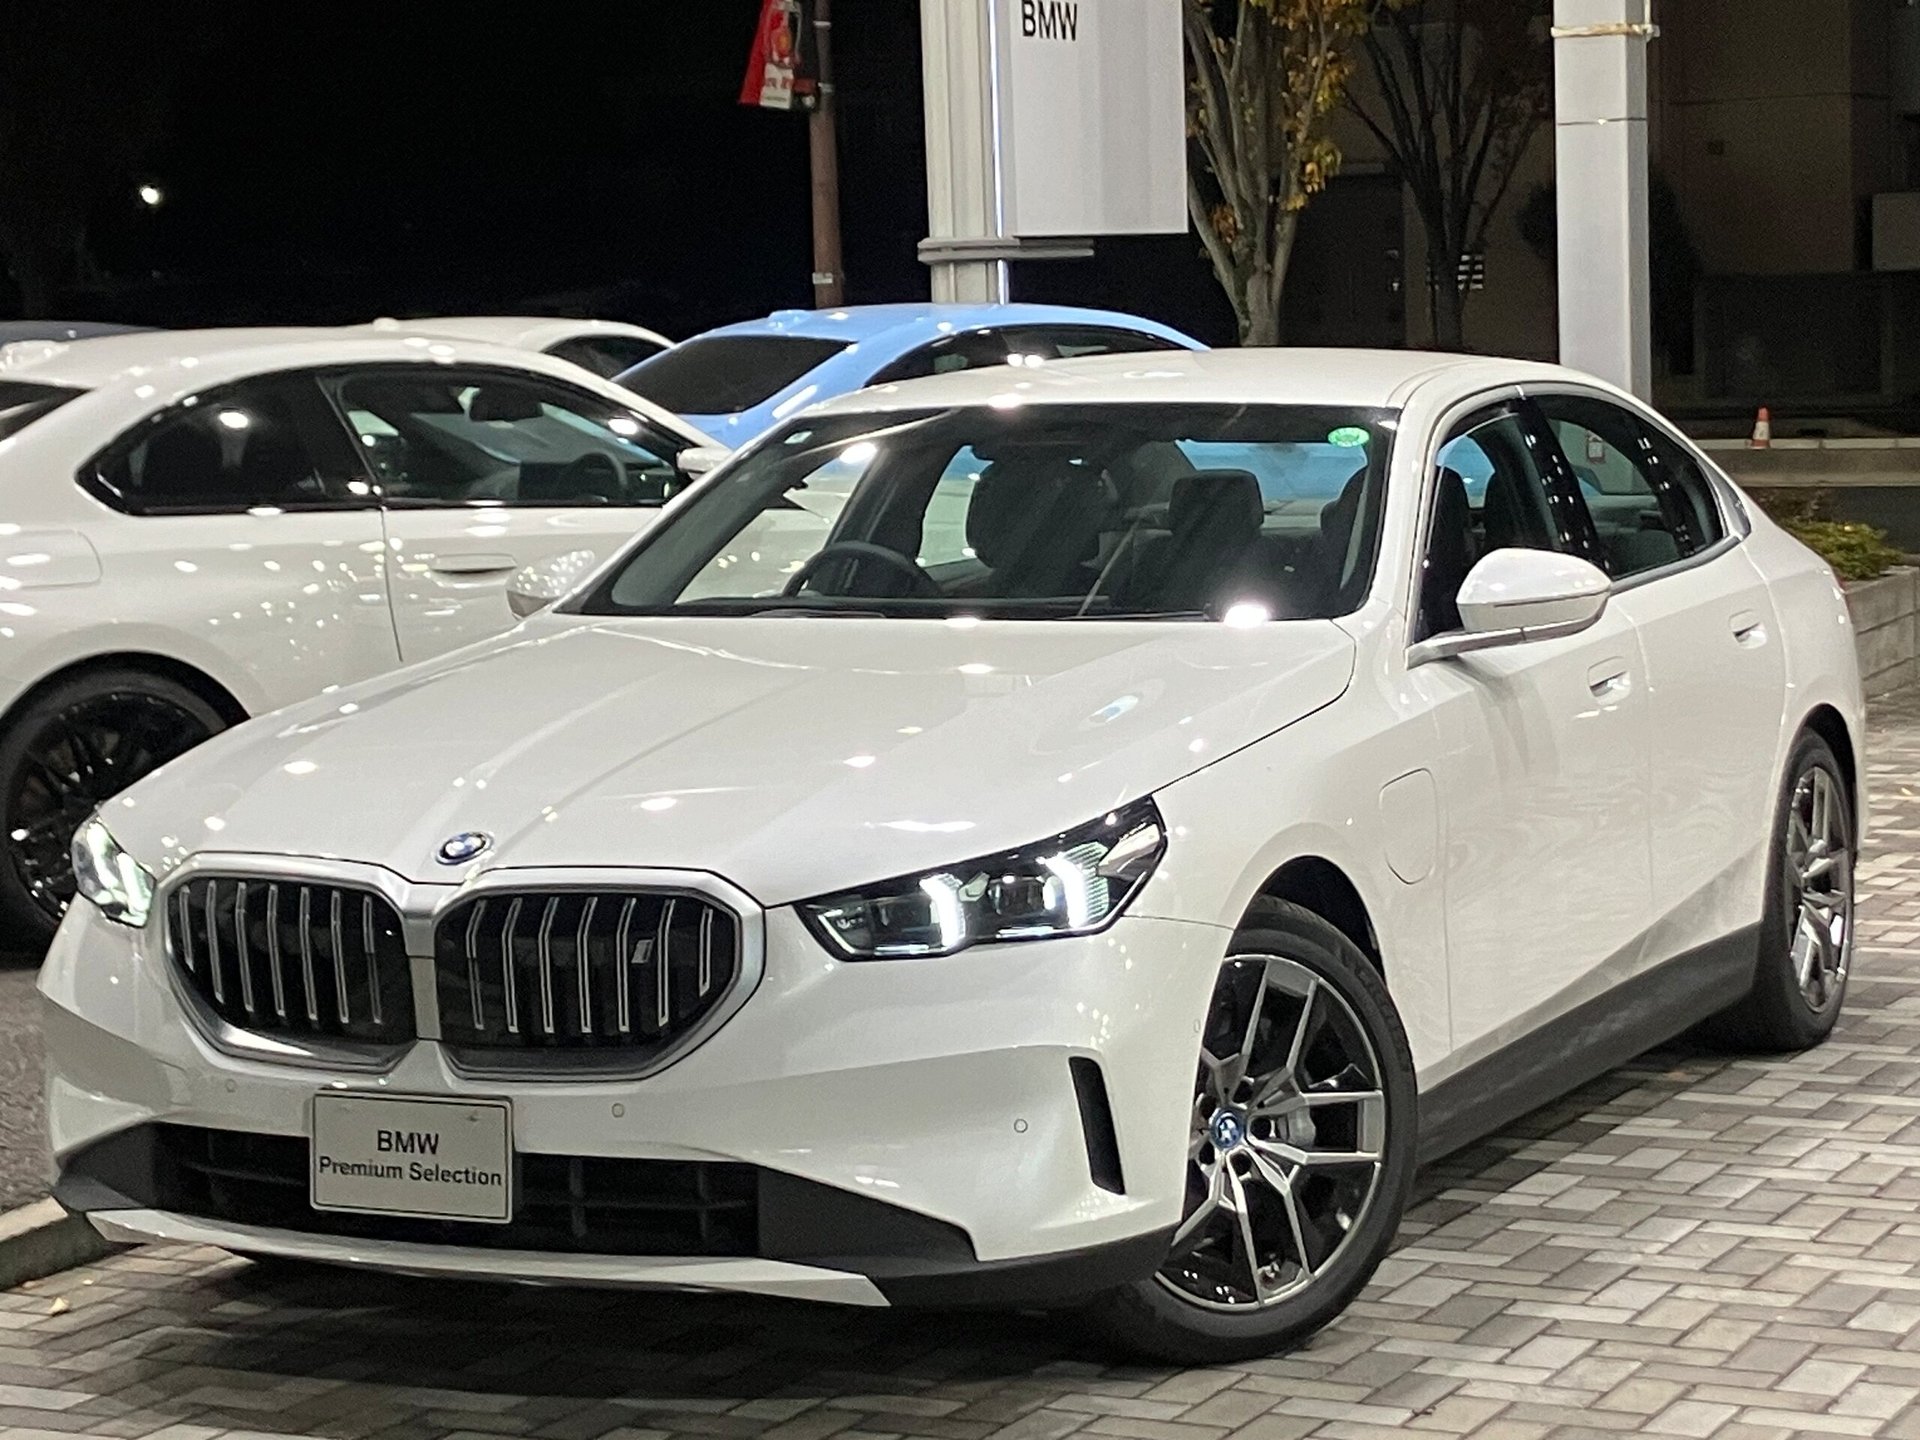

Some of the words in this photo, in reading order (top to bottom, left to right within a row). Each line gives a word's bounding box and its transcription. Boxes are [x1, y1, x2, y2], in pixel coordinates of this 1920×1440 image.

[1021, 0, 1077, 41] BMW
[377, 1130, 439, 1155] BMW
[319, 1156, 403, 1180] Premium
[409, 1162, 502, 1186] Selection
